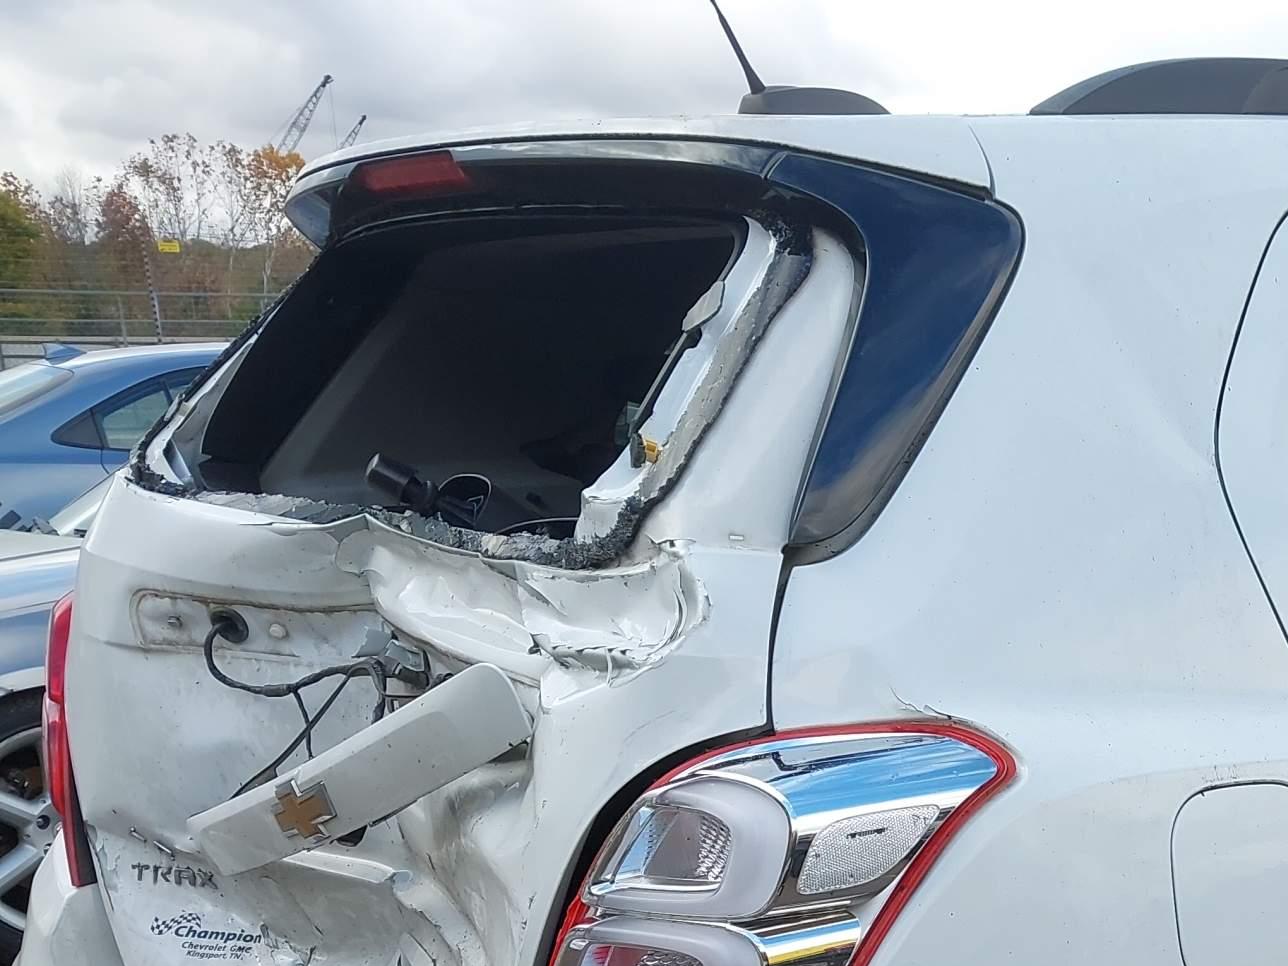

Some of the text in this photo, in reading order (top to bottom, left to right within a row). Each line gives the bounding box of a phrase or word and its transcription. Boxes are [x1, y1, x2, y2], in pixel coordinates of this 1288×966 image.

[131, 862, 219, 890] TRAX
[174, 925, 262, 945] Champion
[181, 941, 253, 954] Chevrolet GMC
